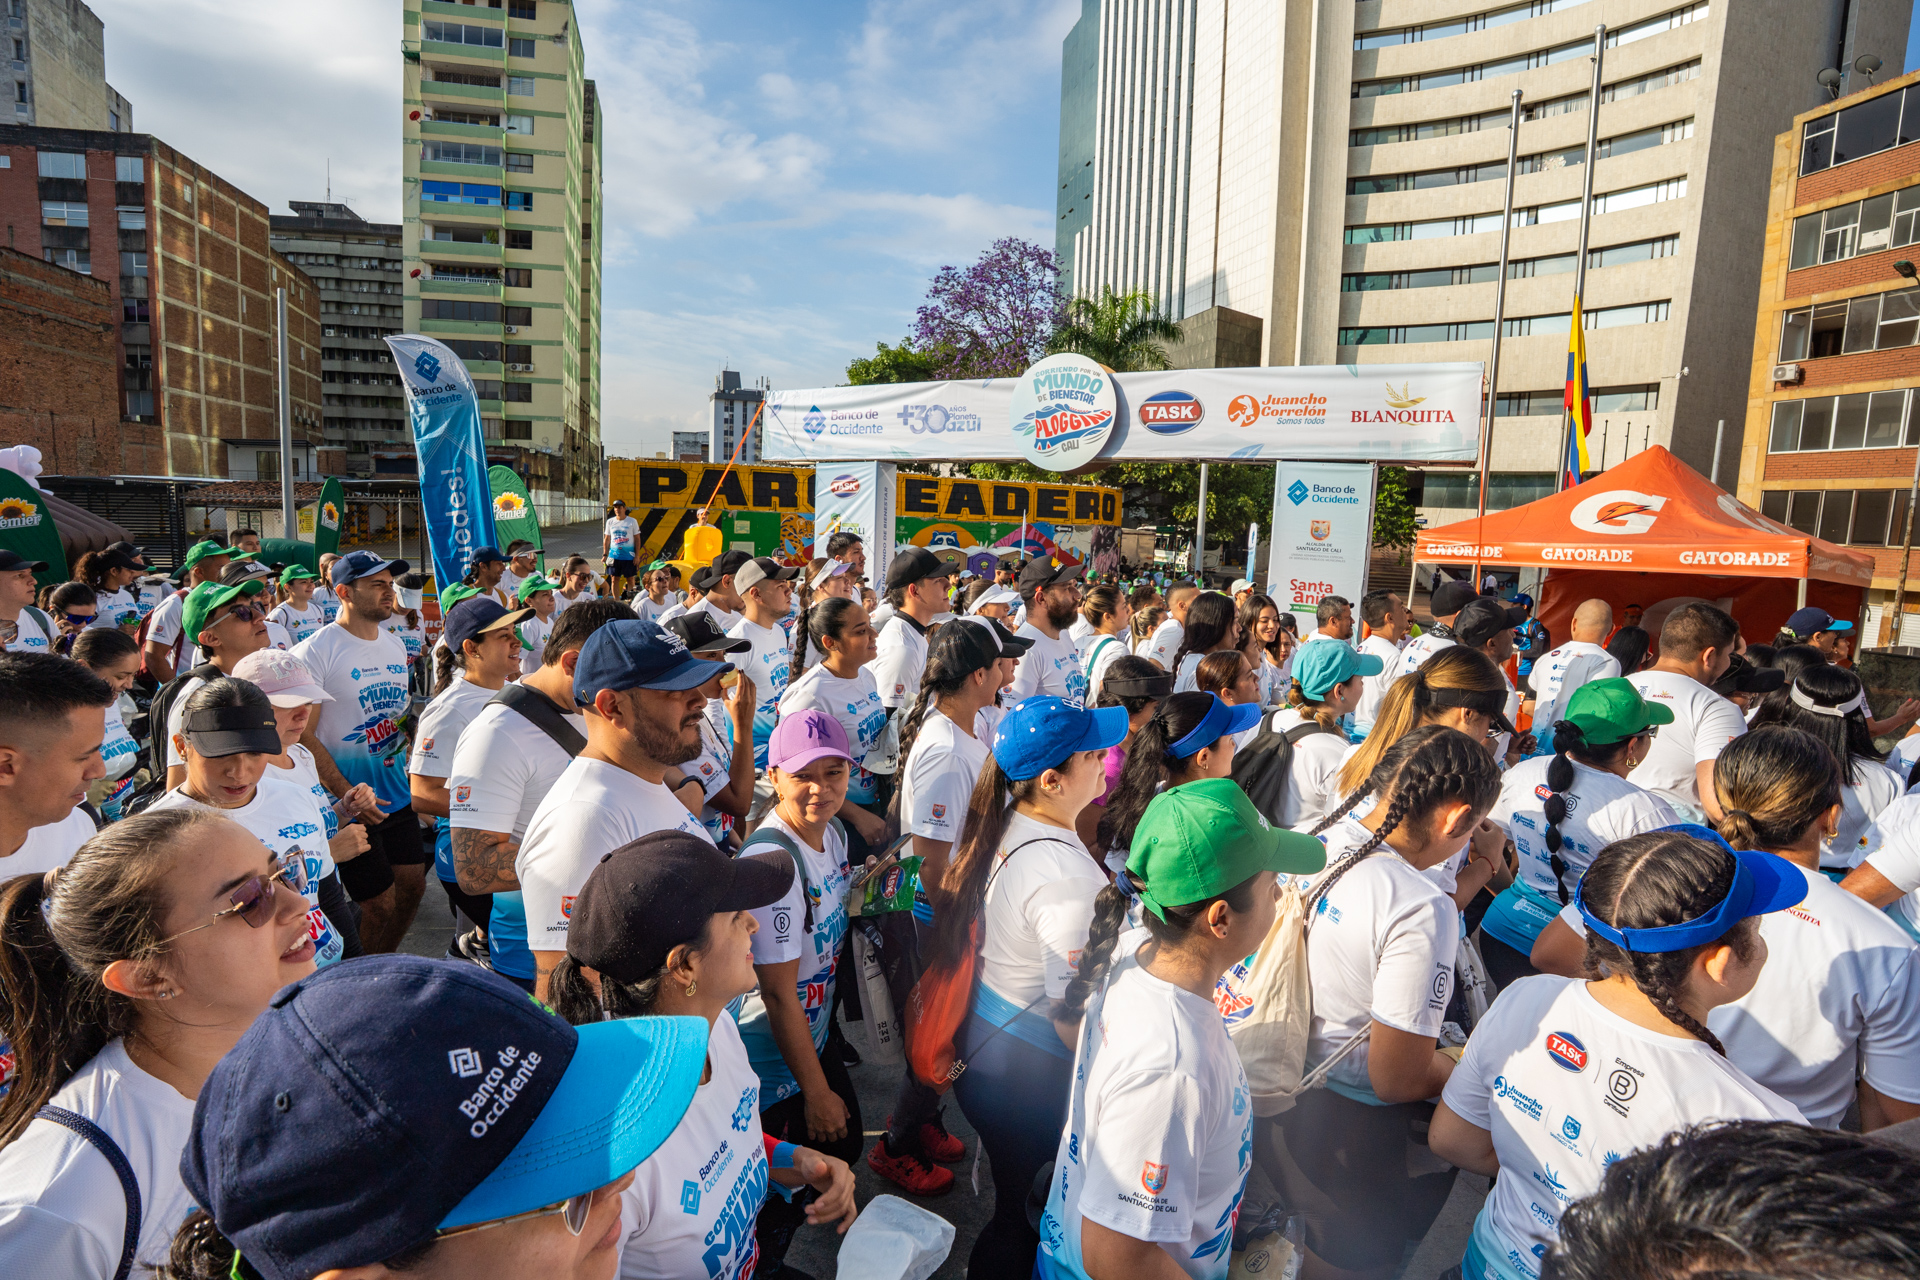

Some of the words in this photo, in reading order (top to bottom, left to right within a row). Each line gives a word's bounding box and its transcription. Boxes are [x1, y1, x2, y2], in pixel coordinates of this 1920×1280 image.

[1036, 367, 1078, 377] CORRIENDO
[412, 386, 443, 397] Banco
[444, 383, 456, 392] de
[1033, 373, 1103, 395] MUNDO
[414, 393, 462, 408] Occidente
[1037, 394, 1047, 402] DE
[1049, 390, 1095, 405] BIENESTAR
[1262, 394, 1327, 406] Juancho
[831, 410, 862, 420] Banco
[866, 409, 878, 420] de
[949, 413, 977, 421] Planeta
[1146, 405, 1194, 419] TASK
[1261, 405, 1326, 418] Correlón
[1351, 409, 1456, 423] BLANQUITA
[946, 417, 981, 433] azul
[1035, 410, 1111, 438] PLOGGING
[1276, 417, 1301, 425] Somos
[1304, 417, 1325, 425] todos
[830, 423, 883, 435] Occidente
[1061, 440, 1079, 452] CALI
[639, 467, 1116, 522] PAREADERO
[834, 483, 856, 491] TASK
[1313, 484, 1341, 494] Banco
[1344, 485, 1355, 494] de
[1312, 494, 1359, 504] Occidente
[883, 531, 887, 540] DE
[1426, 544, 1502, 558] GATORADE
[1541, 548, 1633, 563] GATORADE
[1679, 551, 1790, 566] GATORADE
[1290, 579, 1333, 594] Santa
[1293, 591, 1326, 604] anit
[359, 681, 391, 694] CORRIENDO
[366, 719, 398, 744] PLOGG
[857, 713, 887, 742] MUND
[102, 740, 140, 761] MUND
[819, 951, 830, 964] DE
[1552, 1037, 1582, 1065] TASK
[1615, 1057, 1644, 1078] Empresa
[458, 1067, 504, 1119] Banco
[497, 1045, 519, 1067] de
[1614, 1074, 1631, 1096] B
[470, 1051, 542, 1138] Occidente
[1508, 1085, 1542, 1110] Juancho
[1507, 1091, 1541, 1117] Correlón
[1513, 1103, 1527, 1116] Somos
[1604, 1099, 1628, 1118] Certificada
[699, 1151, 719, 1181] Banco
[719, 1140, 728, 1154] de
[704, 1149, 734, 1193] Occidente
[1533, 1171, 1574, 1205] BLANQUIT
[704, 1159, 753, 1246] CORRIENDO
[752, 1147, 763, 1162] POR
[1118, 1194, 1154, 1211] SANTIAGO
[702, 1158, 769, 1279] MUND
